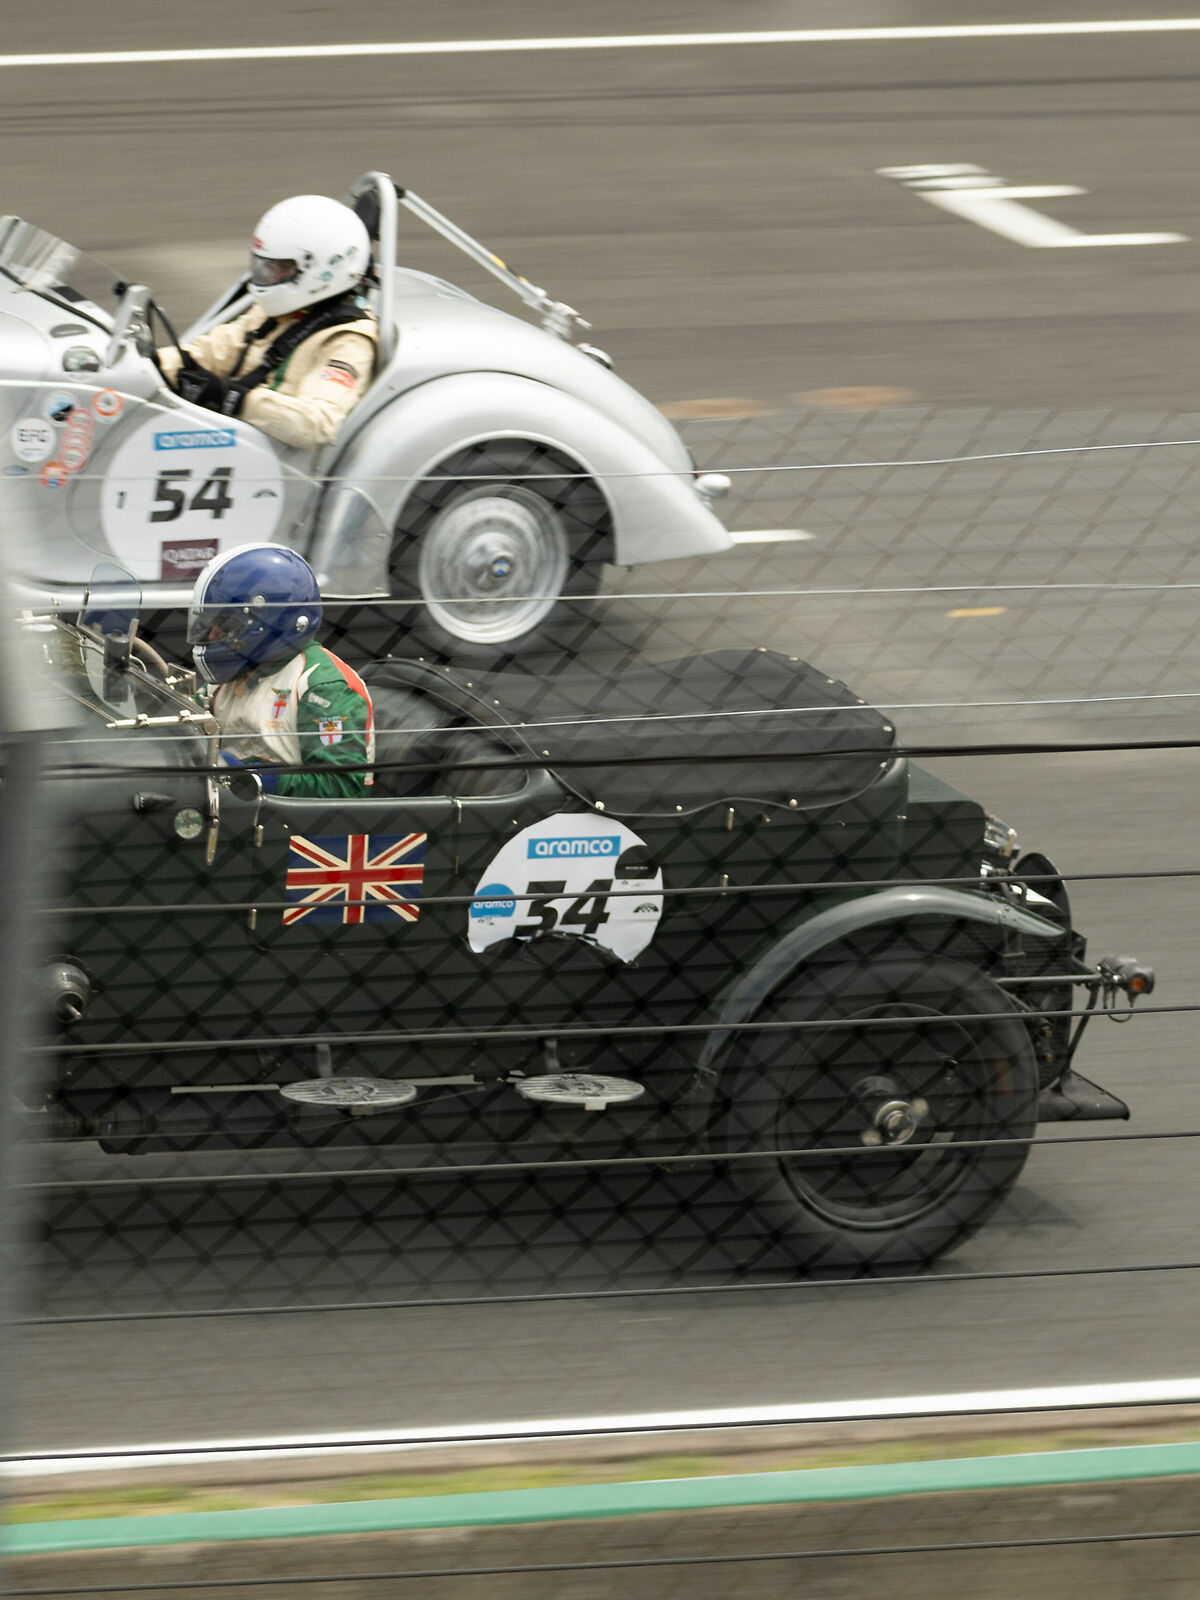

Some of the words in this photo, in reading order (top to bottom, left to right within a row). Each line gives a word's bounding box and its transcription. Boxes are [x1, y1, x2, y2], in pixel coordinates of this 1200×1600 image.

[158, 431, 231, 448] aramco
[148, 466, 234, 523] 54
[535, 839, 613, 856] aramco
[473, 900, 514, 909] aramco
